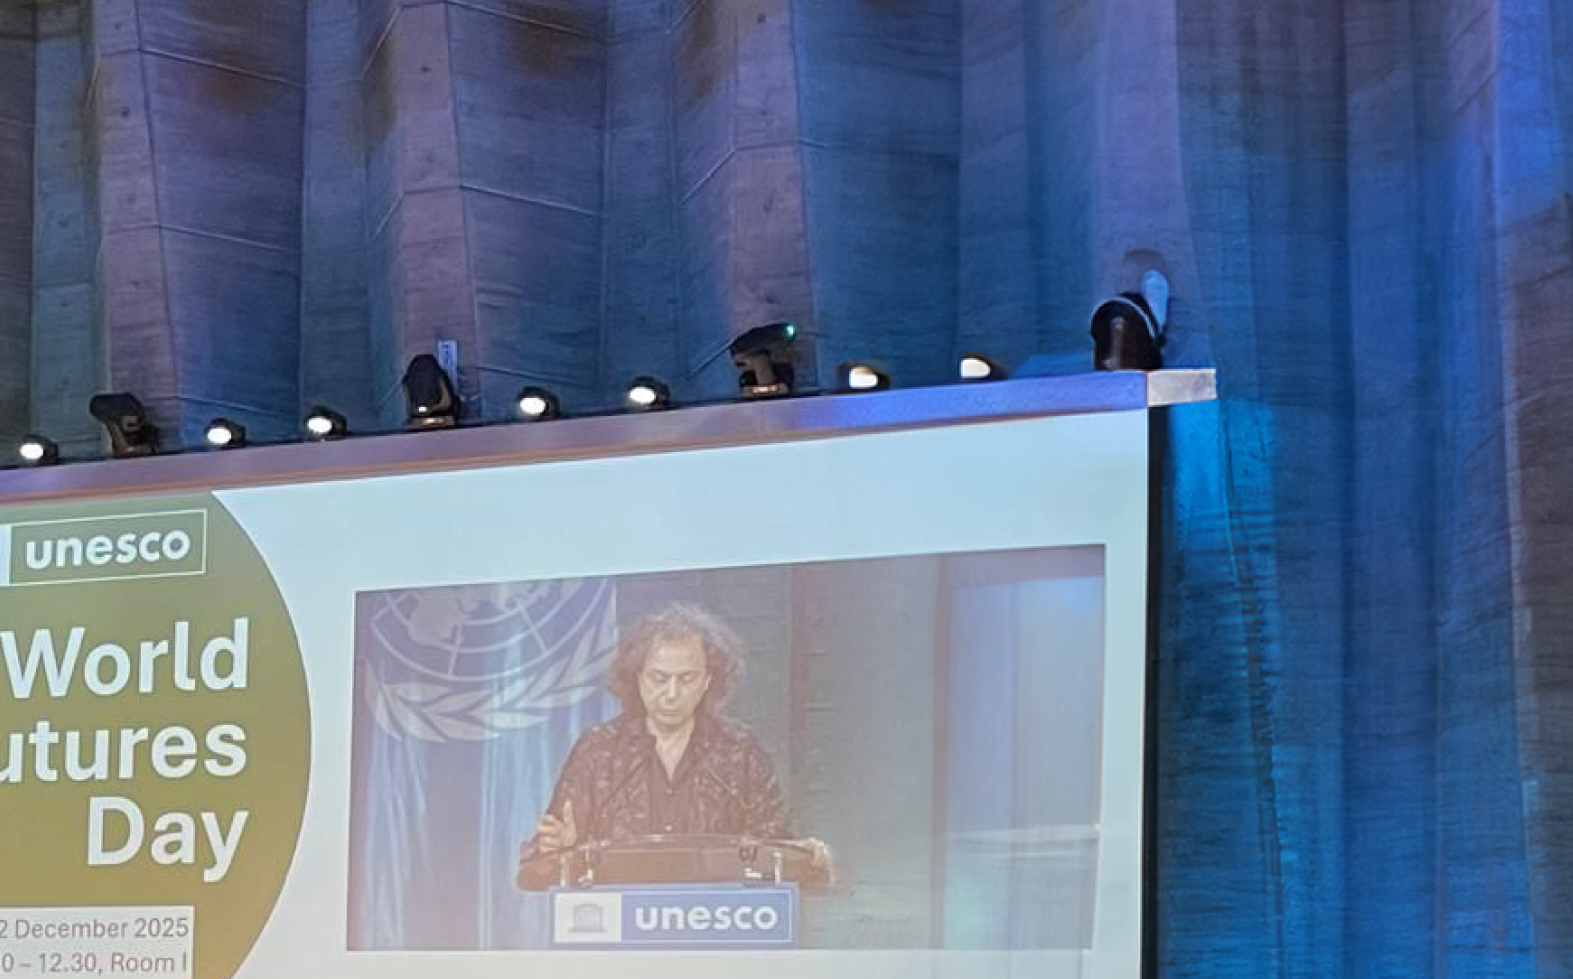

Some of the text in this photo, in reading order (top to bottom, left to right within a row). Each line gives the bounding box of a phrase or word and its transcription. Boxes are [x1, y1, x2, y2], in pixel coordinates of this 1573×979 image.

[26, 529, 190, 569] unesco
[0, 616, 249, 699] World
[87, 796, 249, 882] Day
[15, 919, 128, 939] December
[134, 917, 189, 938] 2025
[635, 905, 778, 930] unesco
[38, 952, 103, 975] 12.30,
[111, 951, 175, 972] Room
